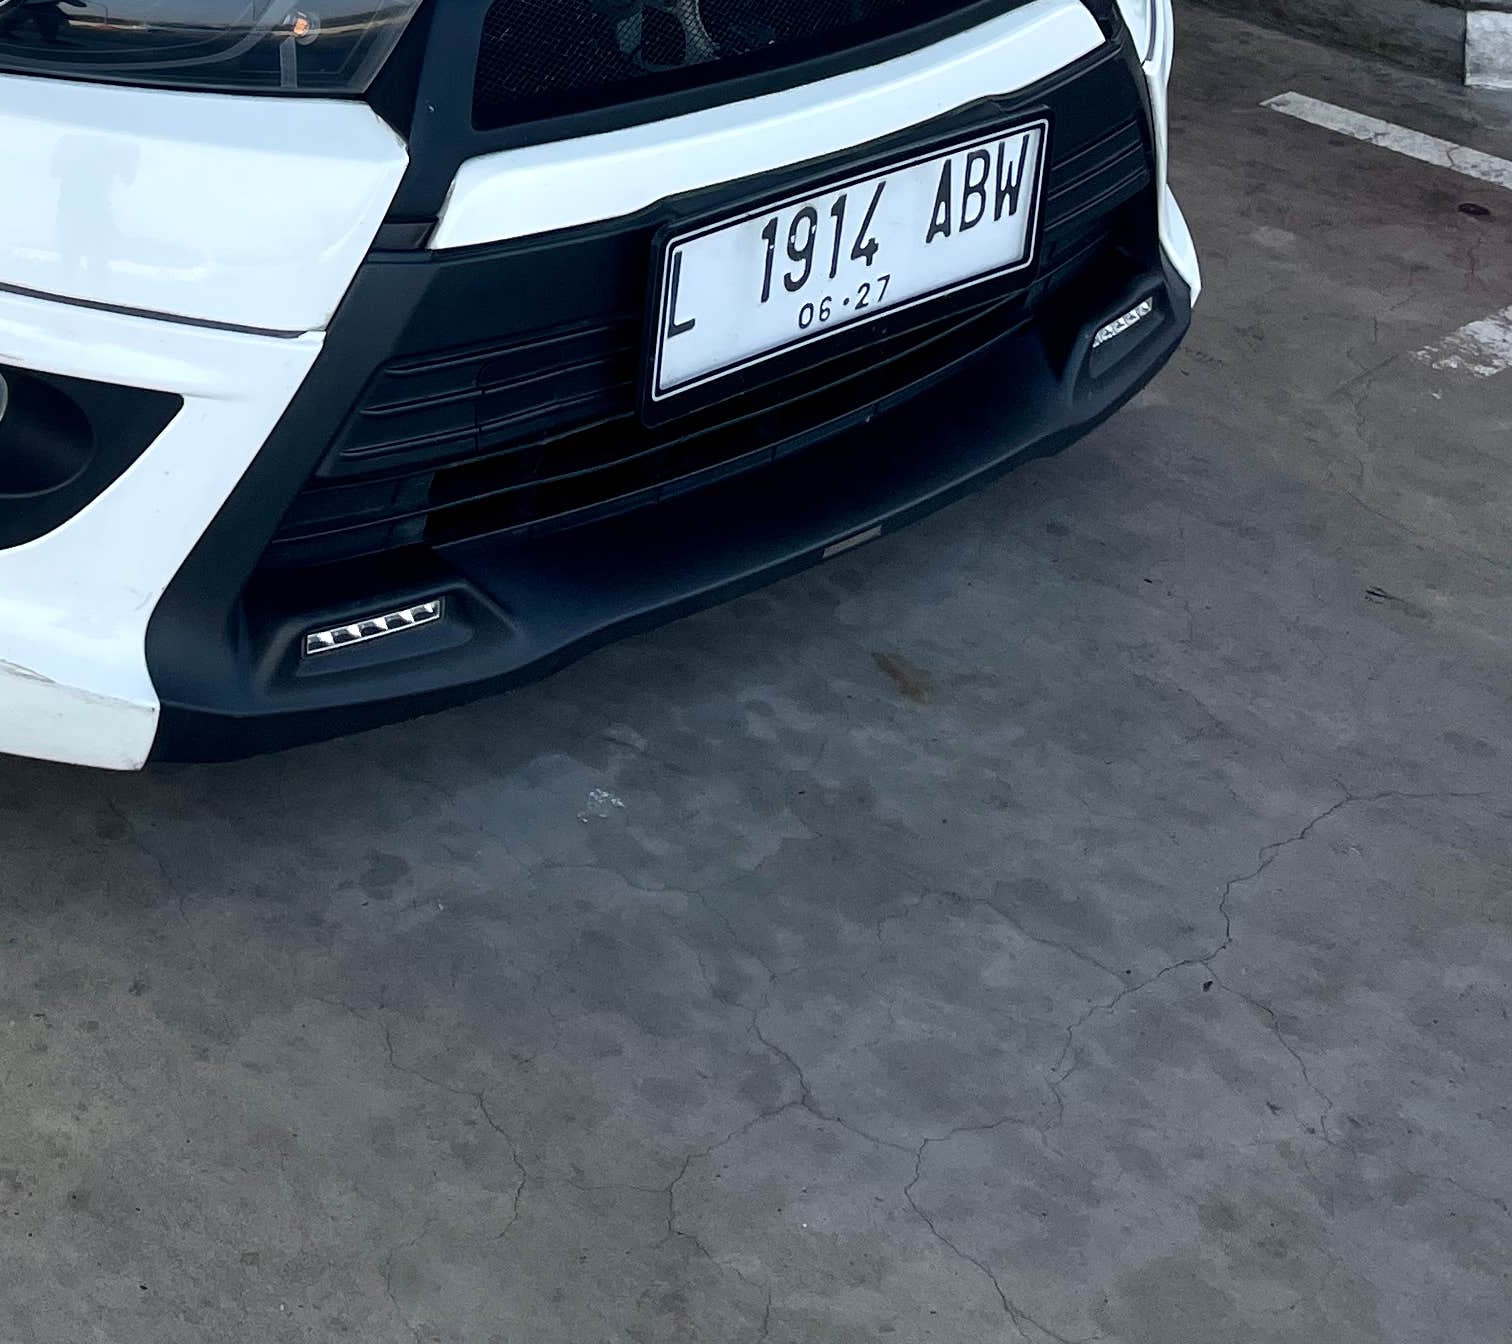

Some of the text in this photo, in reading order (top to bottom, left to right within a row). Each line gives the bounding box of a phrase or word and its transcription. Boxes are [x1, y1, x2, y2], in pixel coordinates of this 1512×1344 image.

[666, 133, 1031, 339] L 1914 ABW
